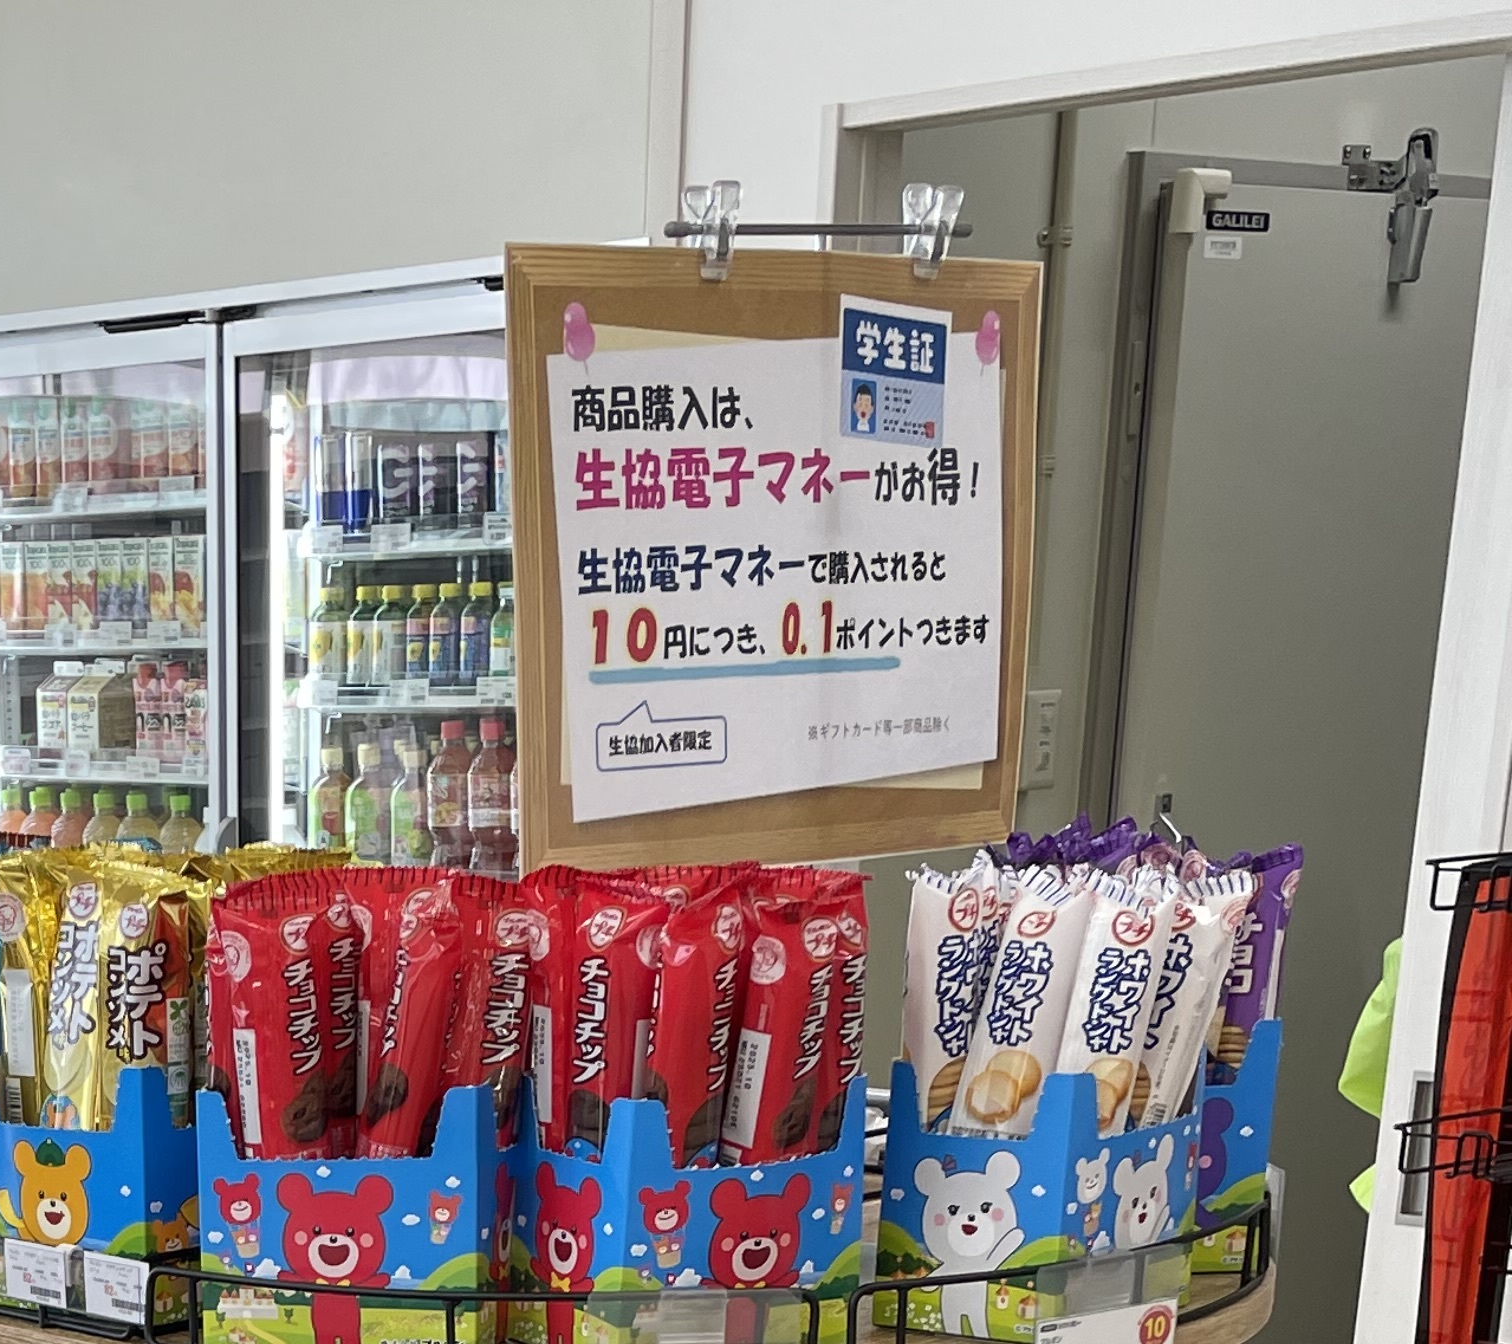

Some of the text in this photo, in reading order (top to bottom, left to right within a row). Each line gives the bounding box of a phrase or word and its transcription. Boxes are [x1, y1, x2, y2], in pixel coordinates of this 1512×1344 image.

[1212, 214, 1266, 229] GALILEI
[855, 319, 935, 375] 学生証
[572, 386, 755, 432] 商品購入は、
[577, 546, 947, 595] 生協電子マネーで購入されると
[608, 730, 712, 757] 生協加入者限定
[124, 943, 167, 1061] ポテト
[284, 958, 323, 1075] チョコチップ
[572, 957, 610, 1084] チョコチップ
[793, 964, 834, 1082] チョコチップ
[1002, 941, 1054, 1047] ホワイト
[1102, 947, 1150, 1053] ホワイト
[1144, 1315, 1166, 1339] 10
